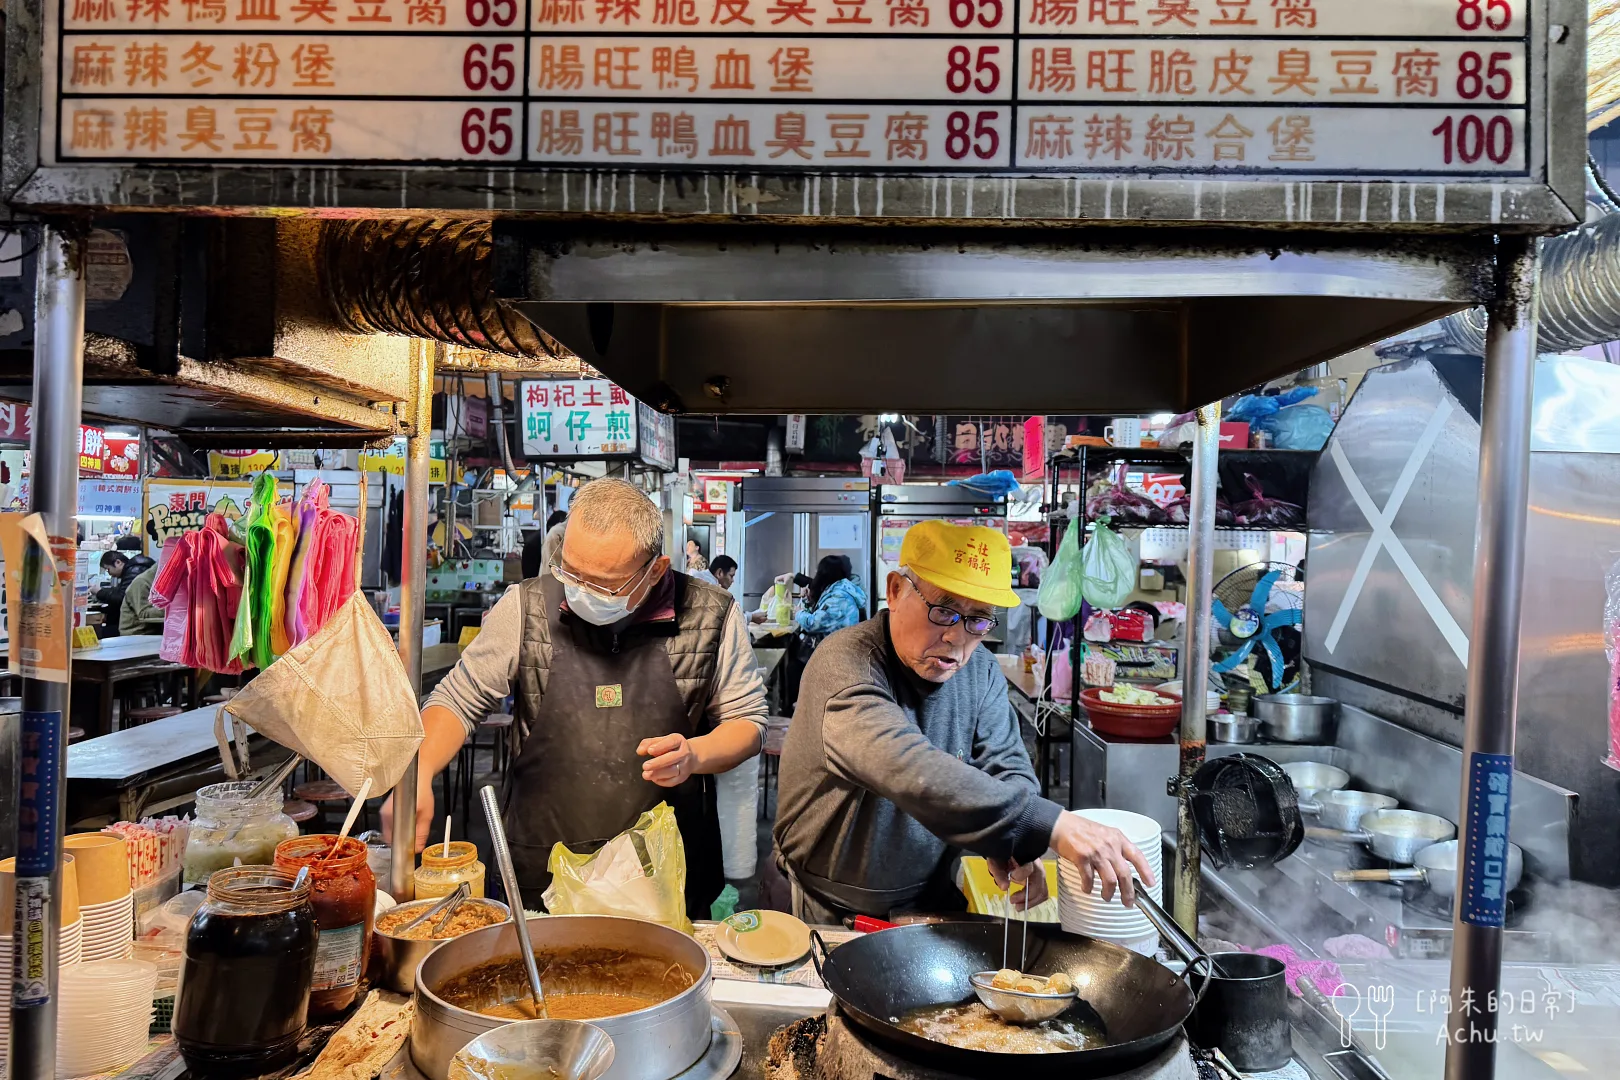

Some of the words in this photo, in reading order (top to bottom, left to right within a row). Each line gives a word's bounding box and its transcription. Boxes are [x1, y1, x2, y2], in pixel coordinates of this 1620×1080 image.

[70, 41, 336, 88] 麻辣冬粉堡
[463, 43, 515, 91] 65
[537, 44, 814, 93] 腸旺鴨血堡
[946, 45, 1000, 94] 85
[1028, 47, 1441, 97] 腸旺脆皮臭豆腐
[1456, 51, 1512, 99] 85
[69, 106, 336, 154] 麻辣臭豆腐
[461, 107, 513, 155] 65
[536, 109, 930, 161] 腸旺鴨血臭豆腐
[945, 111, 1000, 160] 85
[1024, 113, 1317, 161] 麻辣綜合堡
[1432, 115, 1513, 164] 100
[527, 384, 630, 408] 枸杞土虱
[527, 410, 631, 441] 蚵仔煎
[170, 491, 206, 512] 東門
